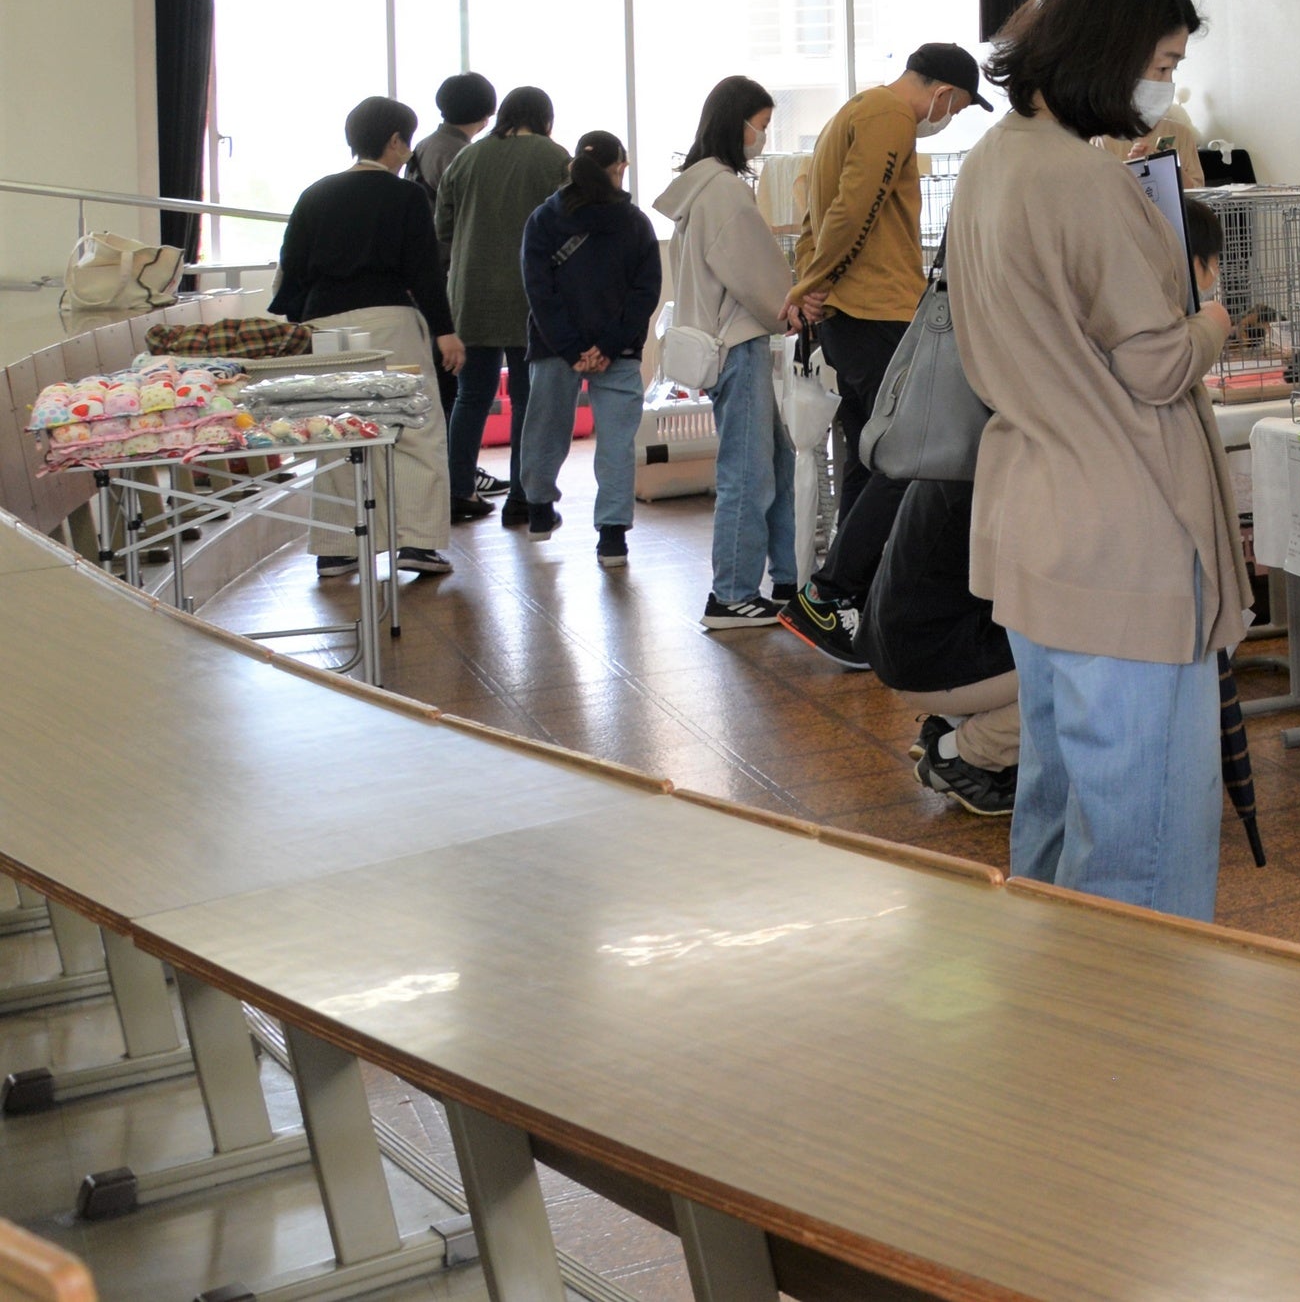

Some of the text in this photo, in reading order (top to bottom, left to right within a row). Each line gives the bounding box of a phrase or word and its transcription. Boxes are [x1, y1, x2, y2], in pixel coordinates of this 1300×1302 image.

[825, 151, 898, 285] THE NORTH FACE
